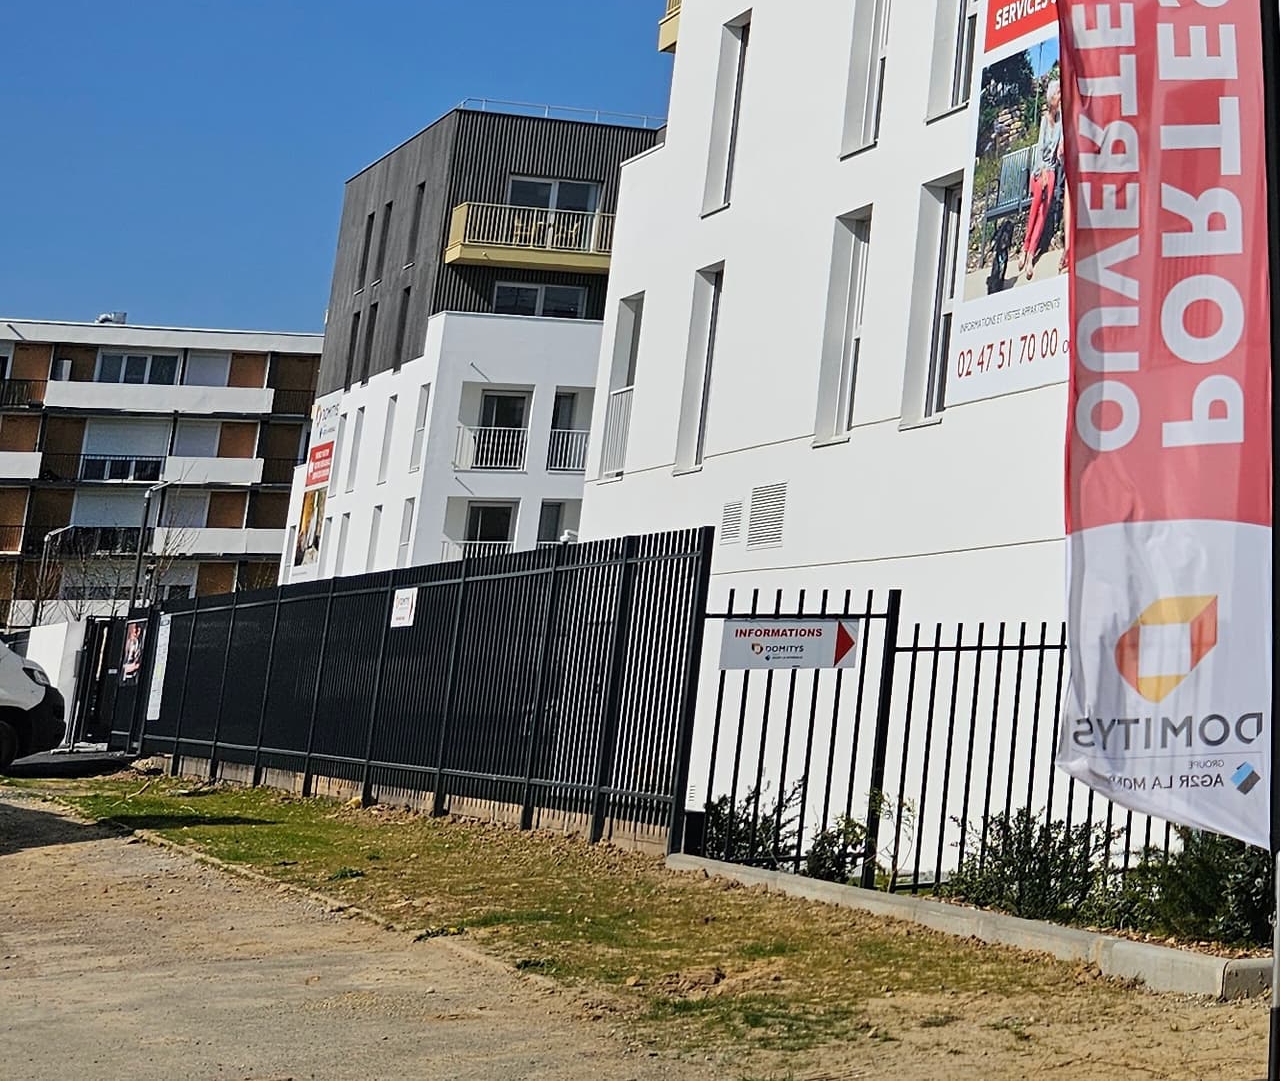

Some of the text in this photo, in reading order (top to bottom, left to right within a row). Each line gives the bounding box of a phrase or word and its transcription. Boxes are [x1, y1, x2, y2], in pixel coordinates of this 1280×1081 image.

[957, 349, 973, 378] 02
[977, 343, 994, 373] 47
[997, 338, 1013, 369] 51
[1020, 333, 1036, 364] 70
[1041, 327, 1058, 359] 00
[735, 628, 823, 639] INFORMATIONS
[765, 644, 804, 653] DOMITYS
